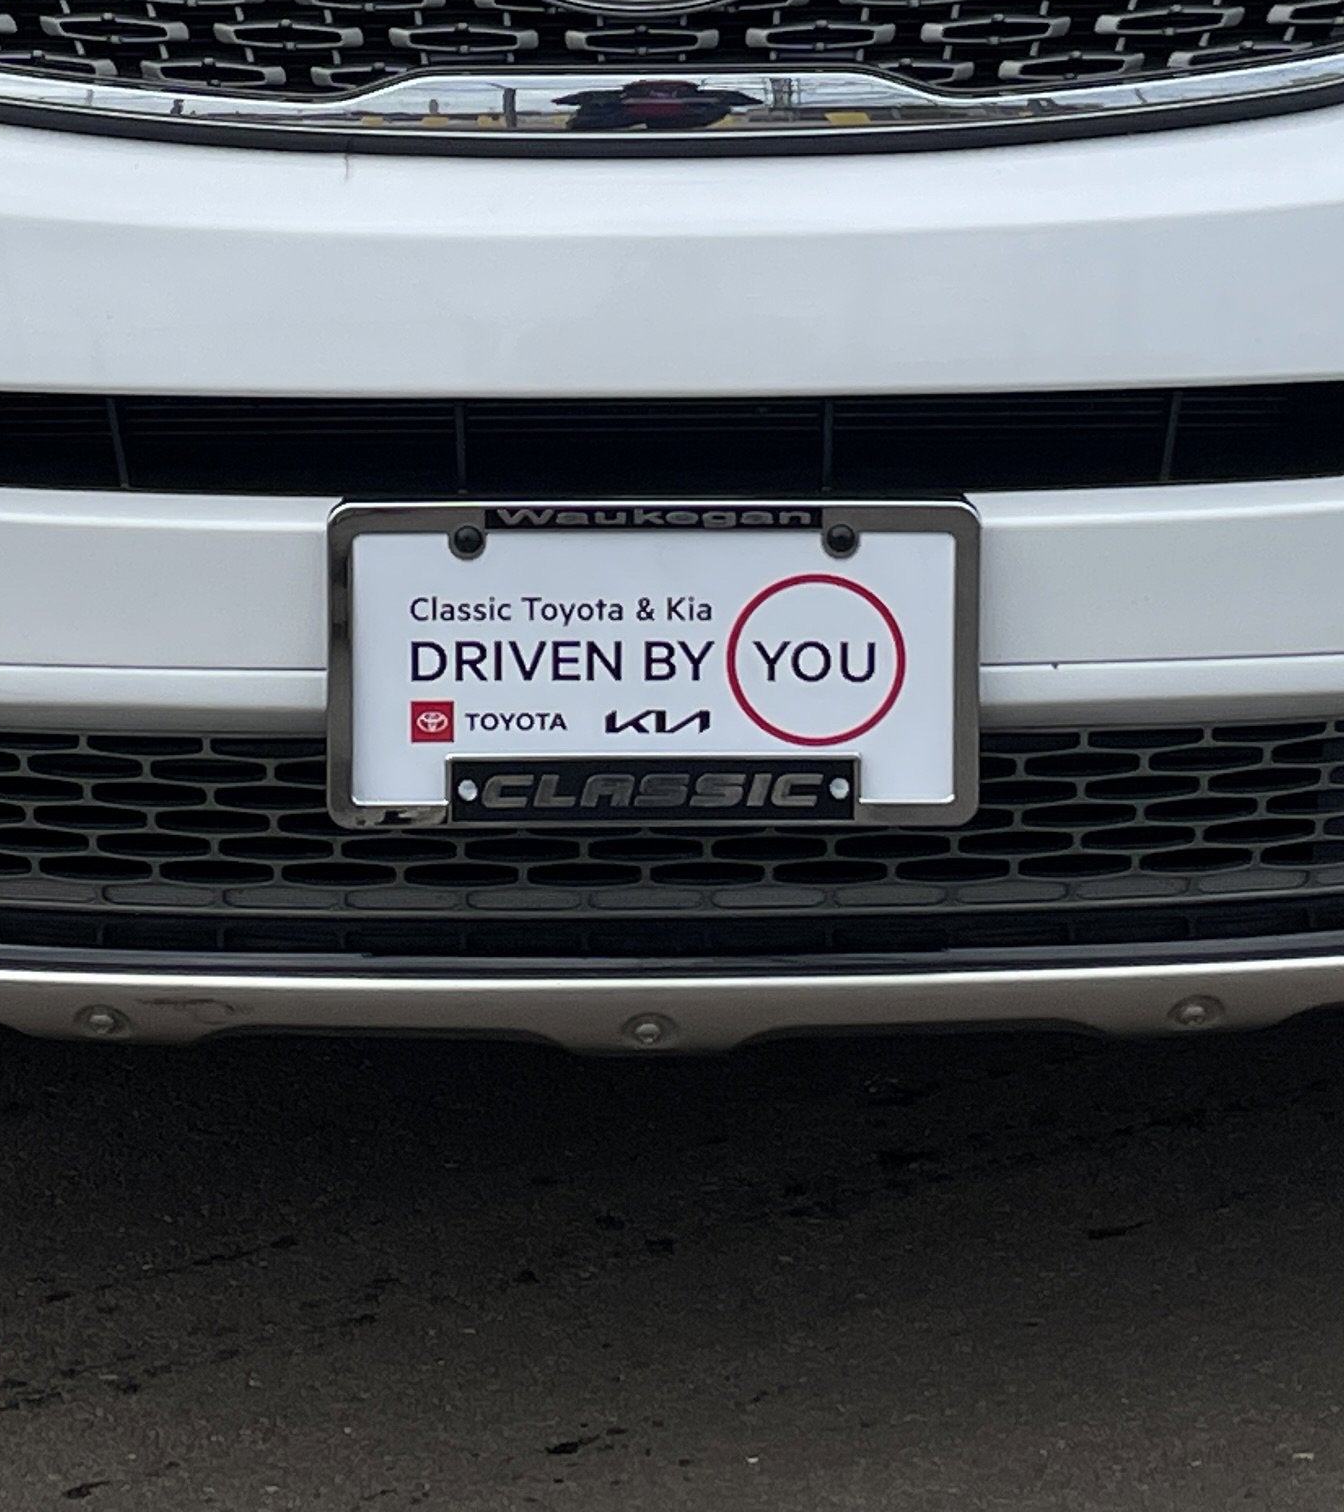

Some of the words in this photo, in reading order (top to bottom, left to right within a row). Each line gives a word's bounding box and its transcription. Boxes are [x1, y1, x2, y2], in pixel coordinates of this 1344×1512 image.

[409, 596, 512, 622] Classic
[521, 597, 624, 627] Toyota
[636, 597, 655, 622] &
[666, 597, 713, 622] Kia
[410, 640, 623, 682] DRIVEN
[643, 640, 715, 682] BY
[753, 641, 877, 683] YOU
[464, 713, 568, 732] TOYOTA
[480, 774, 824, 808] CLASSIC
